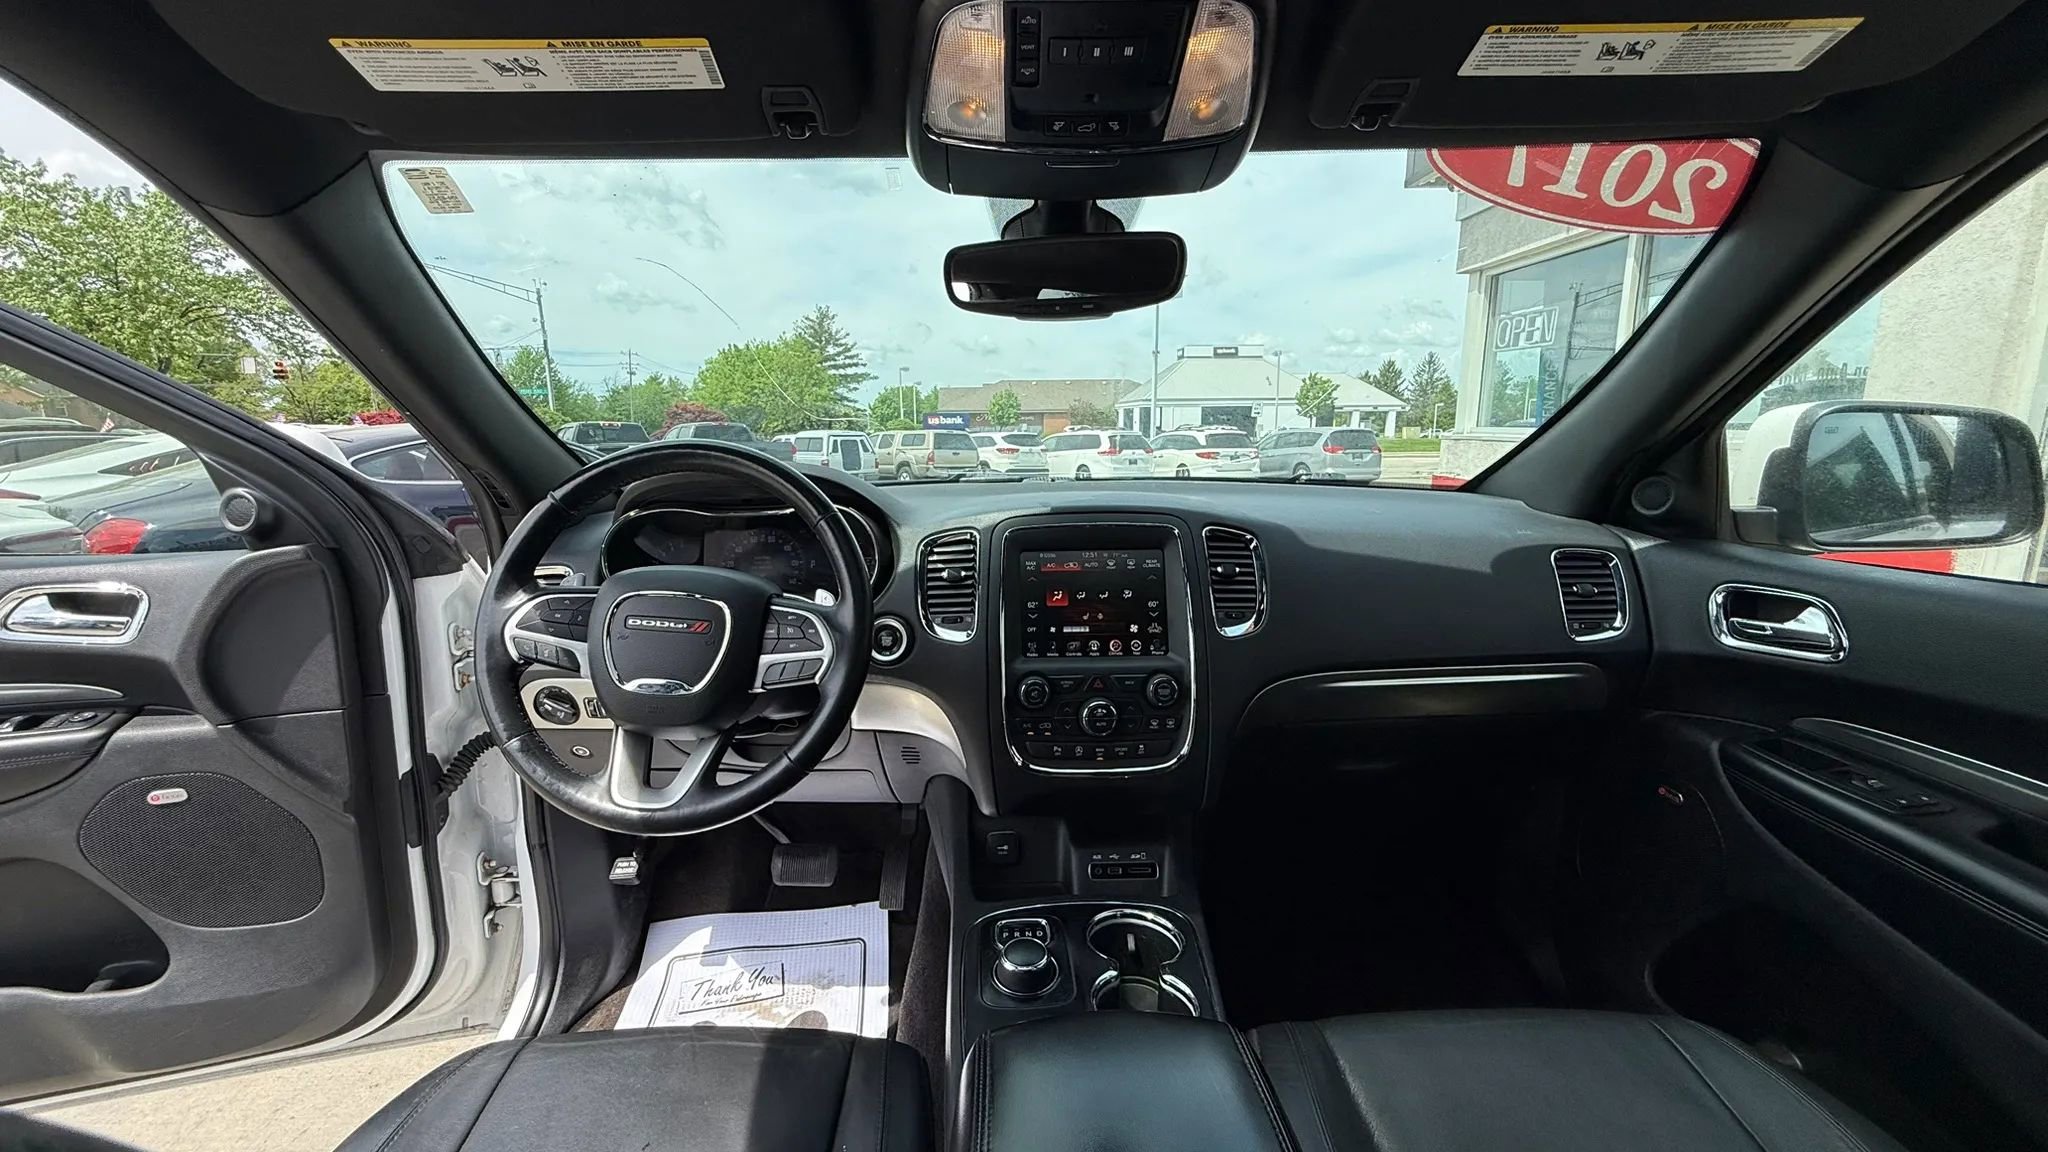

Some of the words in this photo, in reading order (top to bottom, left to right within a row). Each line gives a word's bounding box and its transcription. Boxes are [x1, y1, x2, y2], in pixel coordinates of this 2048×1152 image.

[358, 40, 412, 48] WARNING
[606, 40, 642, 48] GARDE
[1496, 310, 1557, 348] OPEN
[628, 619, 688, 628] DODGE
[691, 970, 745, 1001] Thank
[748, 966, 775, 991] You
